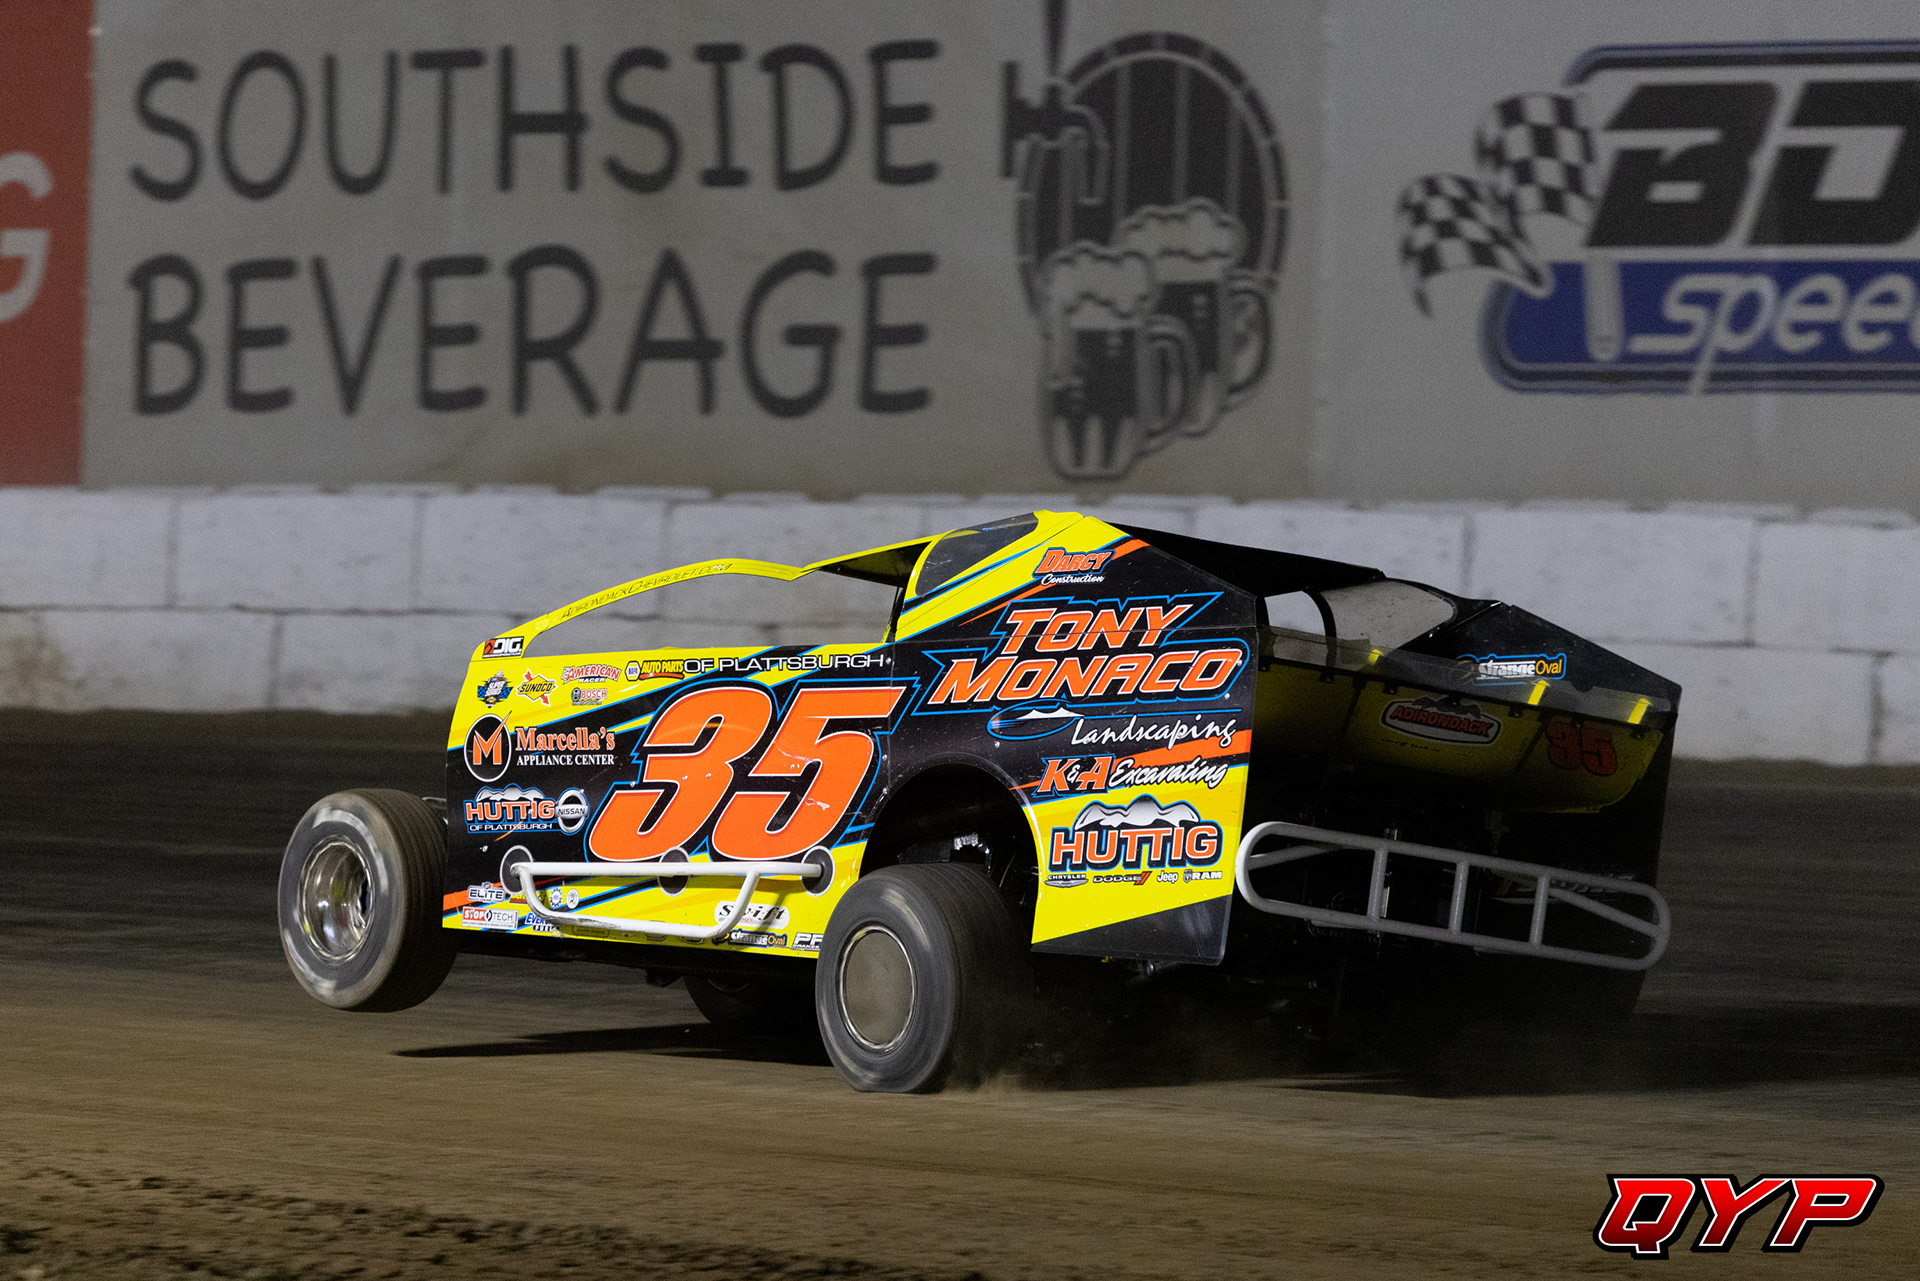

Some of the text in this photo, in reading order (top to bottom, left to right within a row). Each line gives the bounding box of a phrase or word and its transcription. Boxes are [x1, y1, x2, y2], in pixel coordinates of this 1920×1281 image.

[130, 39, 941, 202] SOUTHSIDE
[127, 245, 938, 418] BEVERAGE
[1627, 272, 1920, 394] spee
[1036, 549, 1114, 574] DARCY
[1041, 573, 1105, 586] Construction
[1001, 604, 1193, 655] TONY
[565, 664, 621, 683] AMERICAN
[627, 654, 885, 676] NAPA AUTO PARTS OF PLATTSBURGH
[927, 649, 1242, 704] MONACO
[519, 682, 553, 693] SUNOCO
[581, 688, 607, 699] BOSCH
[1071, 714, 1236, 750] Landscaping
[1390, 705, 1492, 738] ADIRONDACK
[515, 726, 616, 751] Marcella's
[516, 753, 615, 766] APPLIANCE CENTER
[589, 686, 907, 862] 35
[1108, 756, 1229, 789] Excavating
[465, 800, 556, 821] HUTTIG
[557, 807, 586, 815] NISSAN
[469, 823, 553, 832] OF PLATTSBURGH
[1051, 825, 1219, 866] HUTTIG
[1093, 875, 1142, 884] DODGE
[1157, 871, 1179, 884] Jeep
[1191, 871, 1222, 880] RAM
[492, 911, 513, 922] TECH
[794, 932, 824, 945] PF
